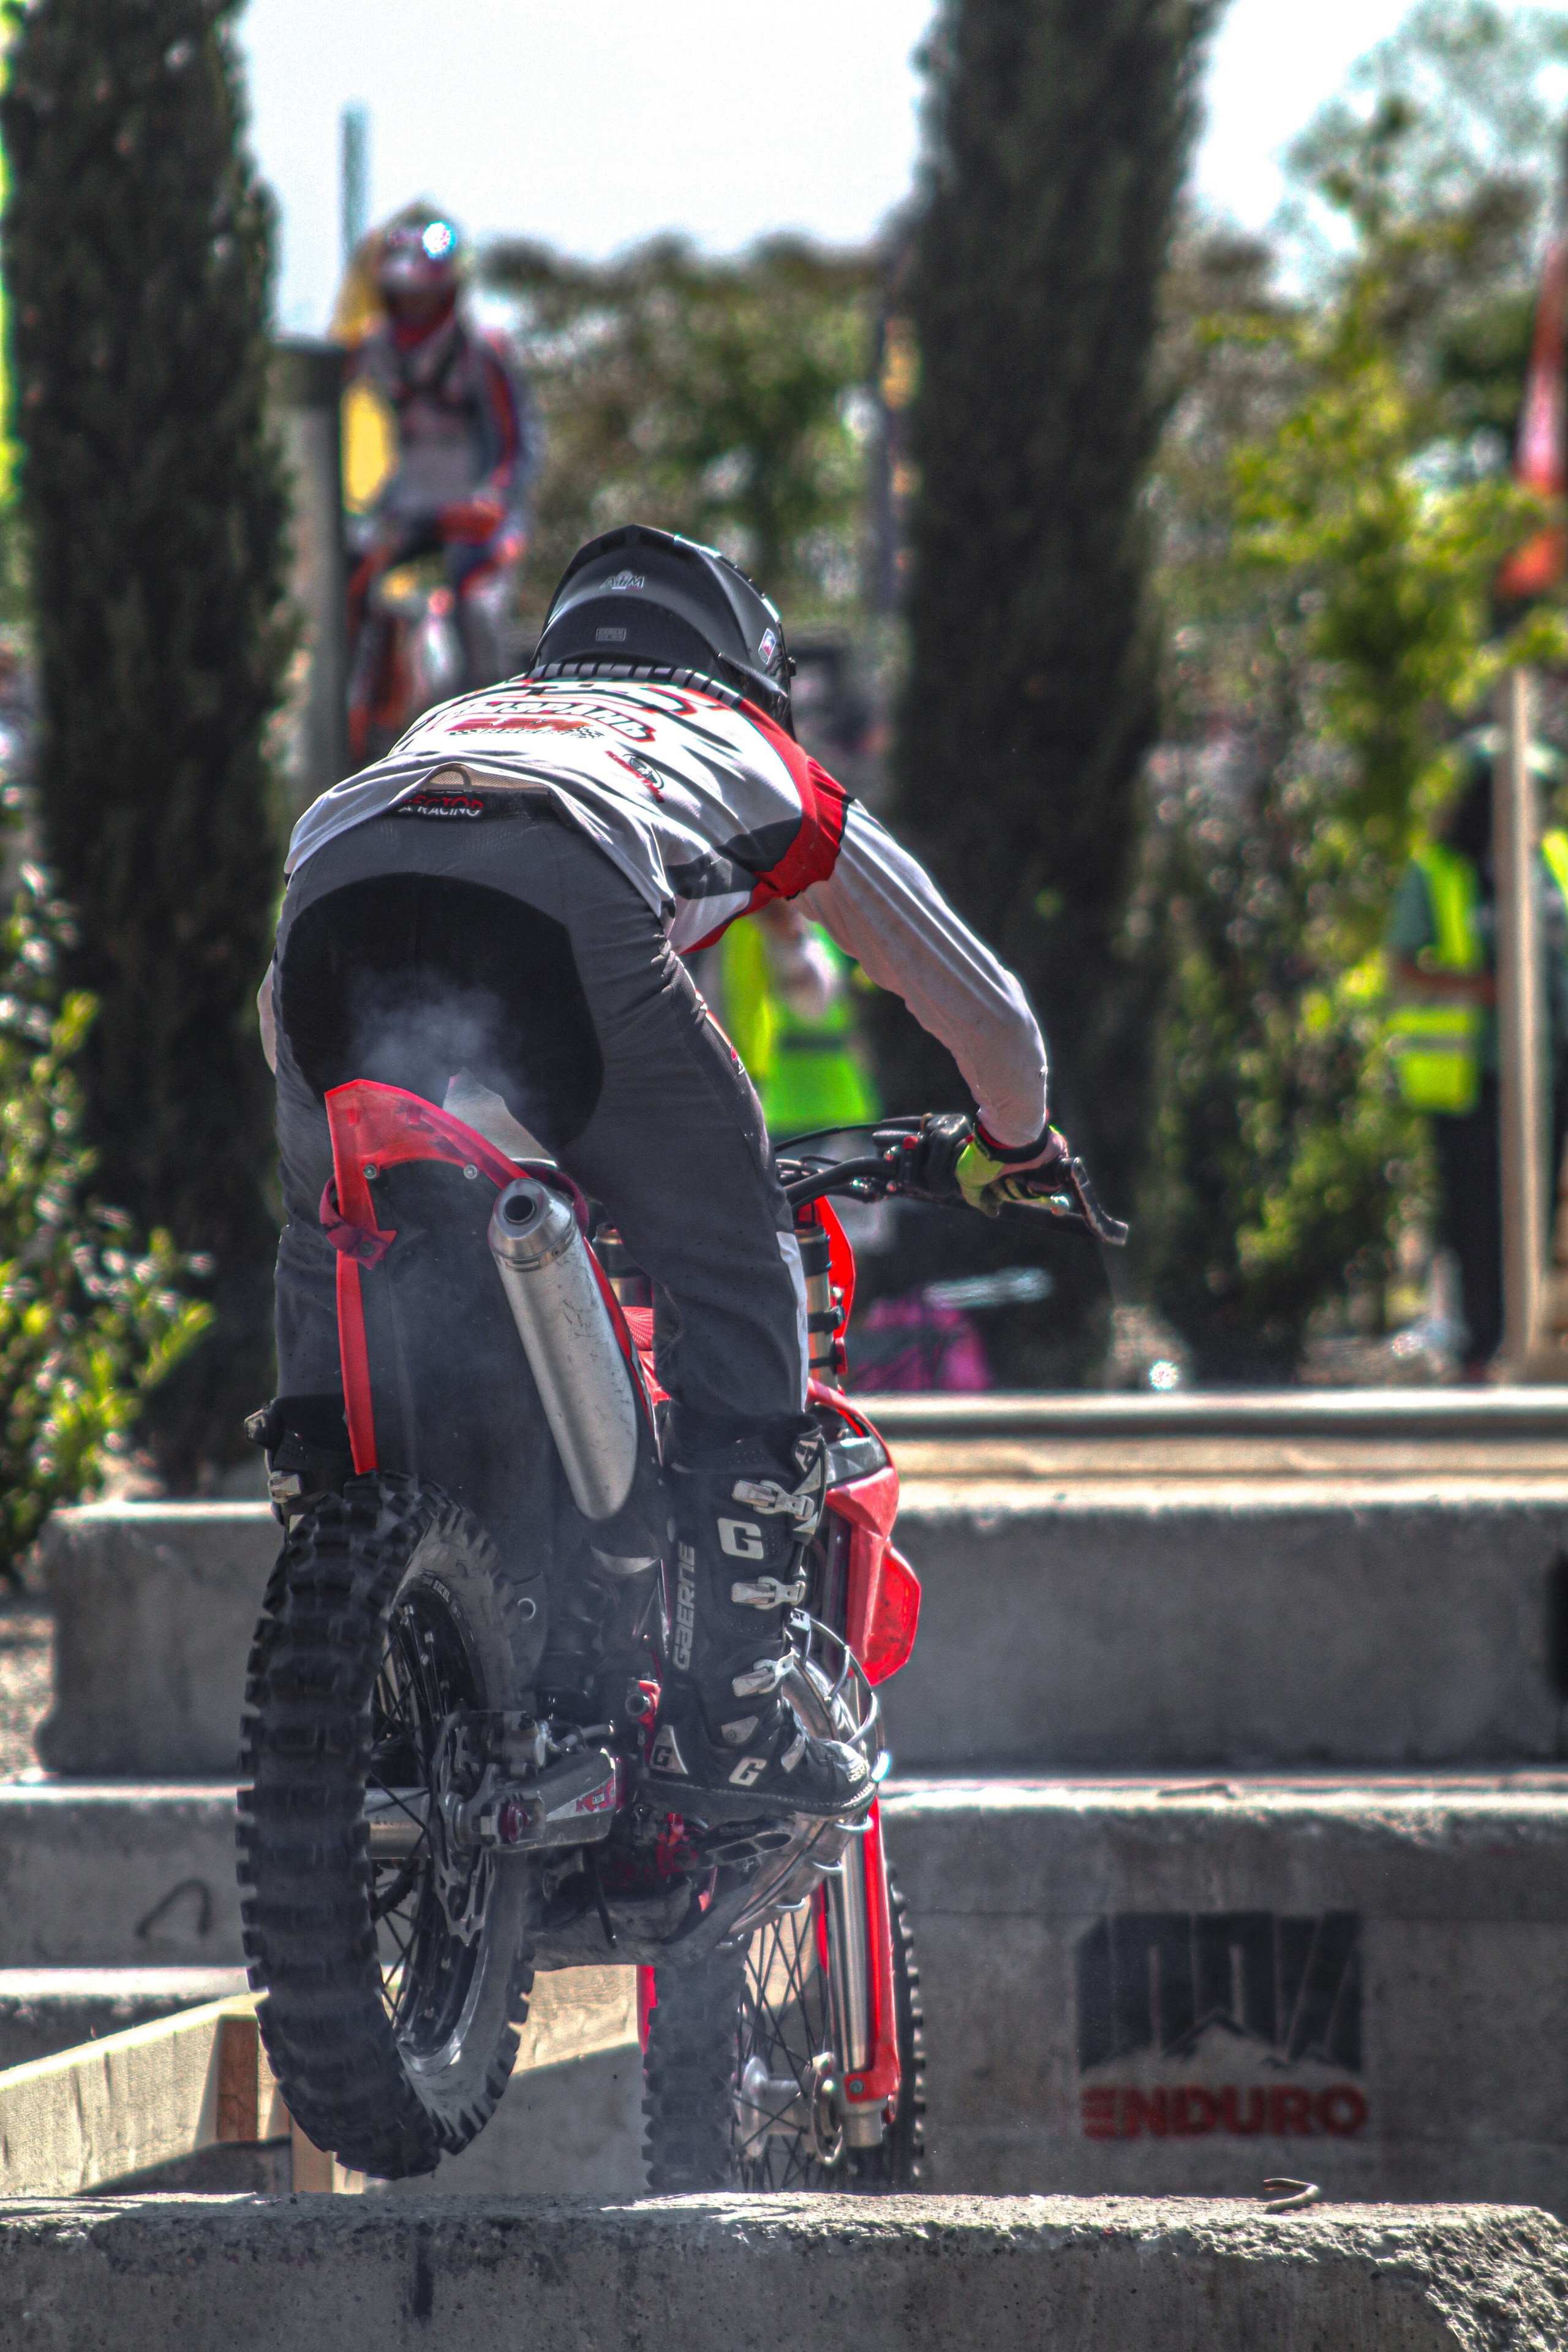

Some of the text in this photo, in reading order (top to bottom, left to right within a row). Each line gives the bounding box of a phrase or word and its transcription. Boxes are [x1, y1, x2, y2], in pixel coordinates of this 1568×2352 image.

[717, 1517, 764, 1560] G
[728, 1756, 767, 1786] G
[1082, 2084, 1368, 2139] ENDURO
